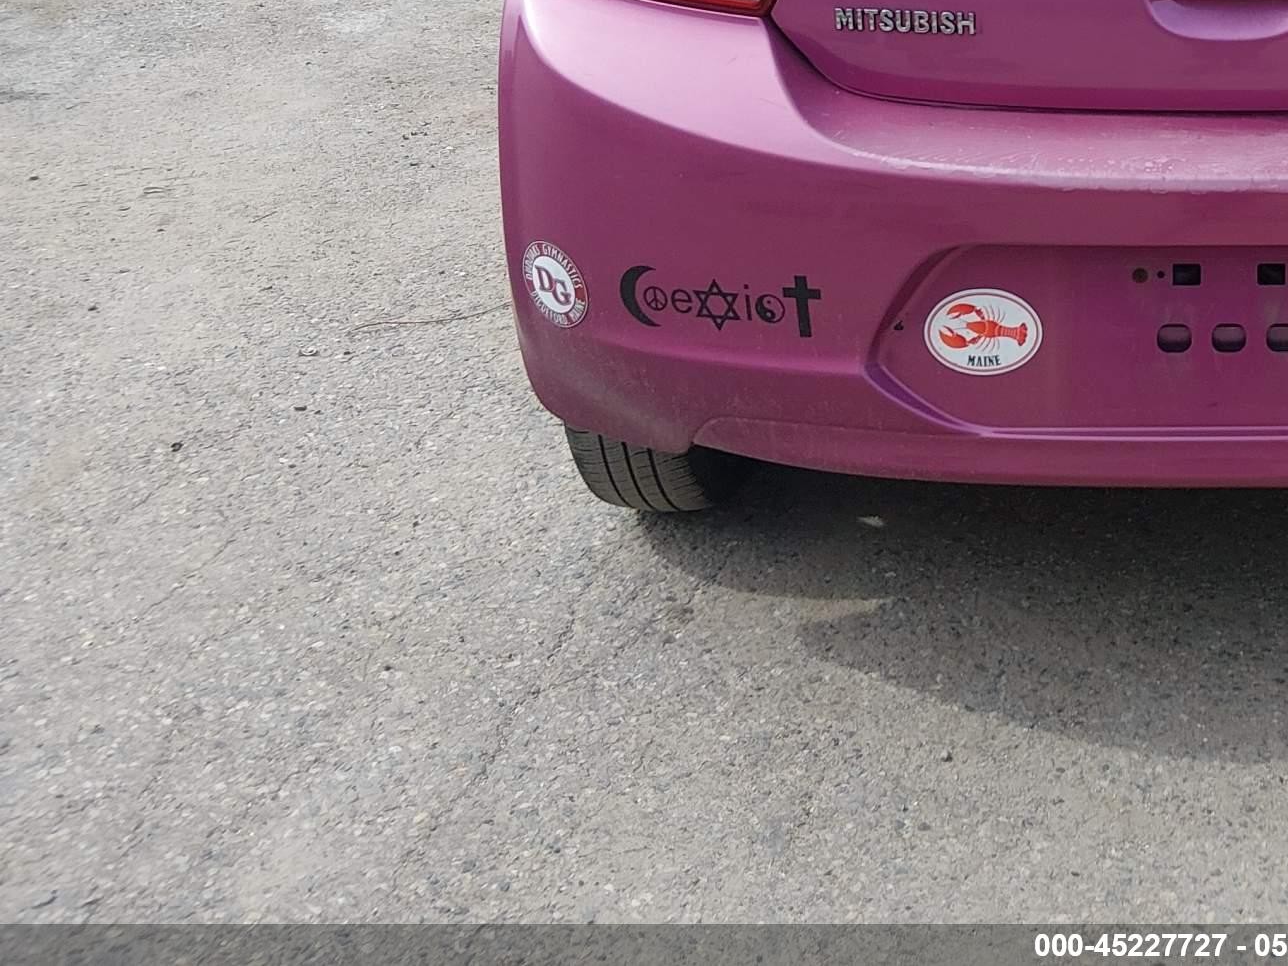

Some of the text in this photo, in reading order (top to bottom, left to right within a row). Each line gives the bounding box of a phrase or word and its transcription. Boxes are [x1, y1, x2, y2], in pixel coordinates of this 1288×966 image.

[834, 7, 977, 35] MITSUBISH
[535, 264, 572, 306] DG
[967, 354, 1001, 367] MAINE
